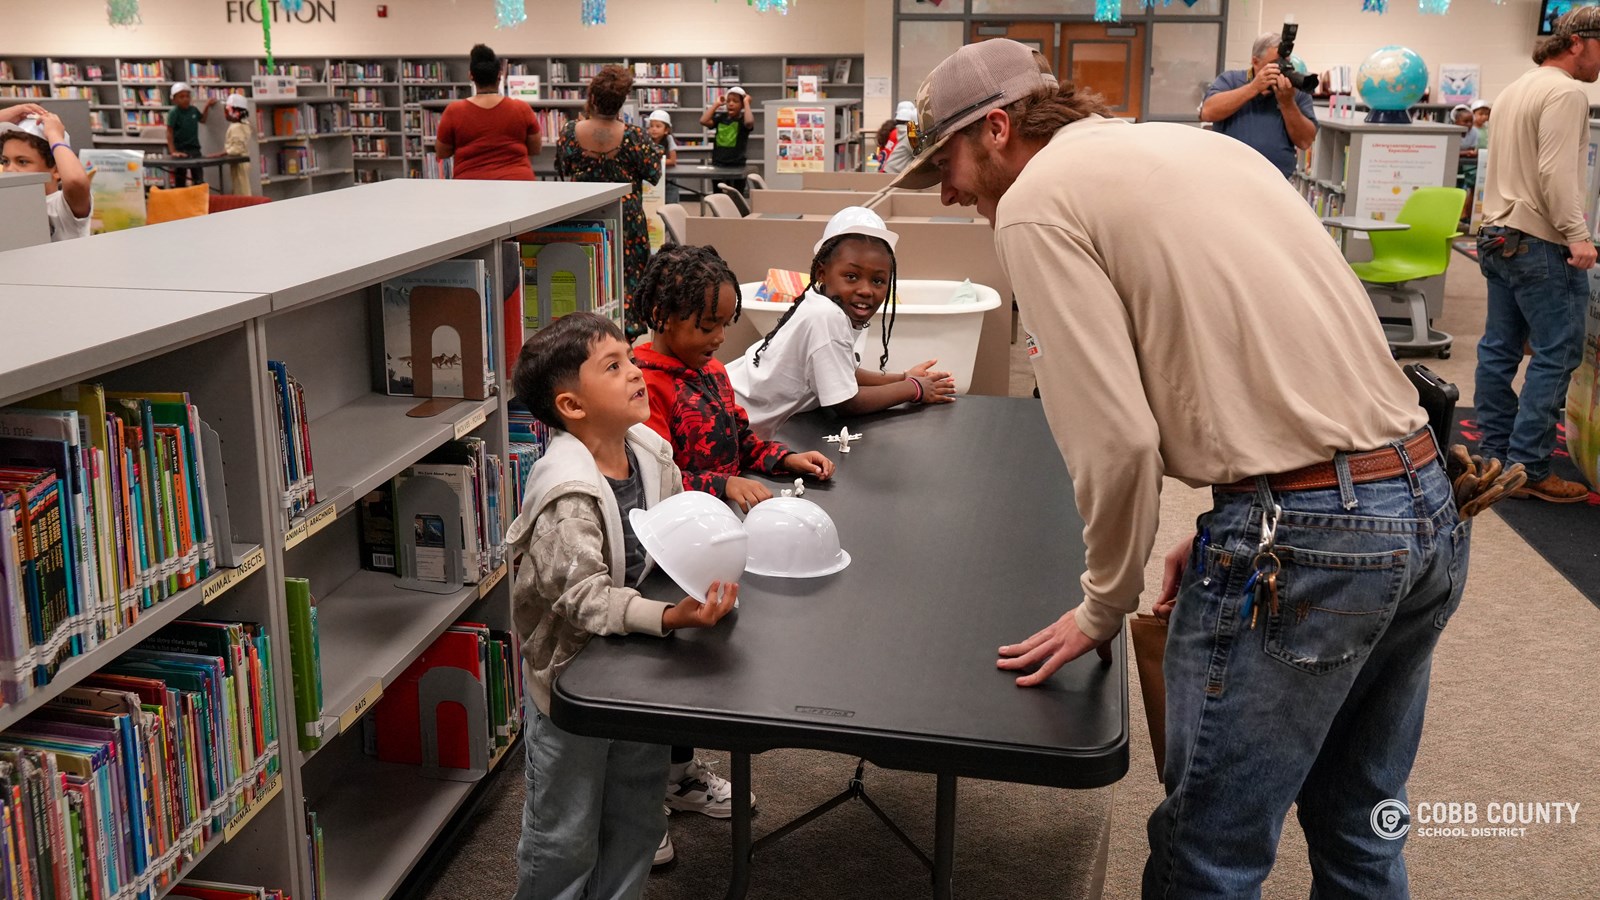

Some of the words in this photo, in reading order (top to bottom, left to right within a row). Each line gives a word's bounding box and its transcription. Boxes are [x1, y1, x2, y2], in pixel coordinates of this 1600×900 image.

[226, 0, 336, 23] FICTION
[13, 426, 33, 437] me
[286, 523, 306, 542] ANIMALS
[310, 505, 335, 526] ARACHNIDS
[18, 542, 26, 562] BOOKS
[204, 574, 231, 599] ANIMAL
[236, 552, 262, 577] INSECTS
[354, 697, 367, 714] BATS
[230, 804, 251, 830] ANIMAL
[256, 778, 277, 804] REPTILES
